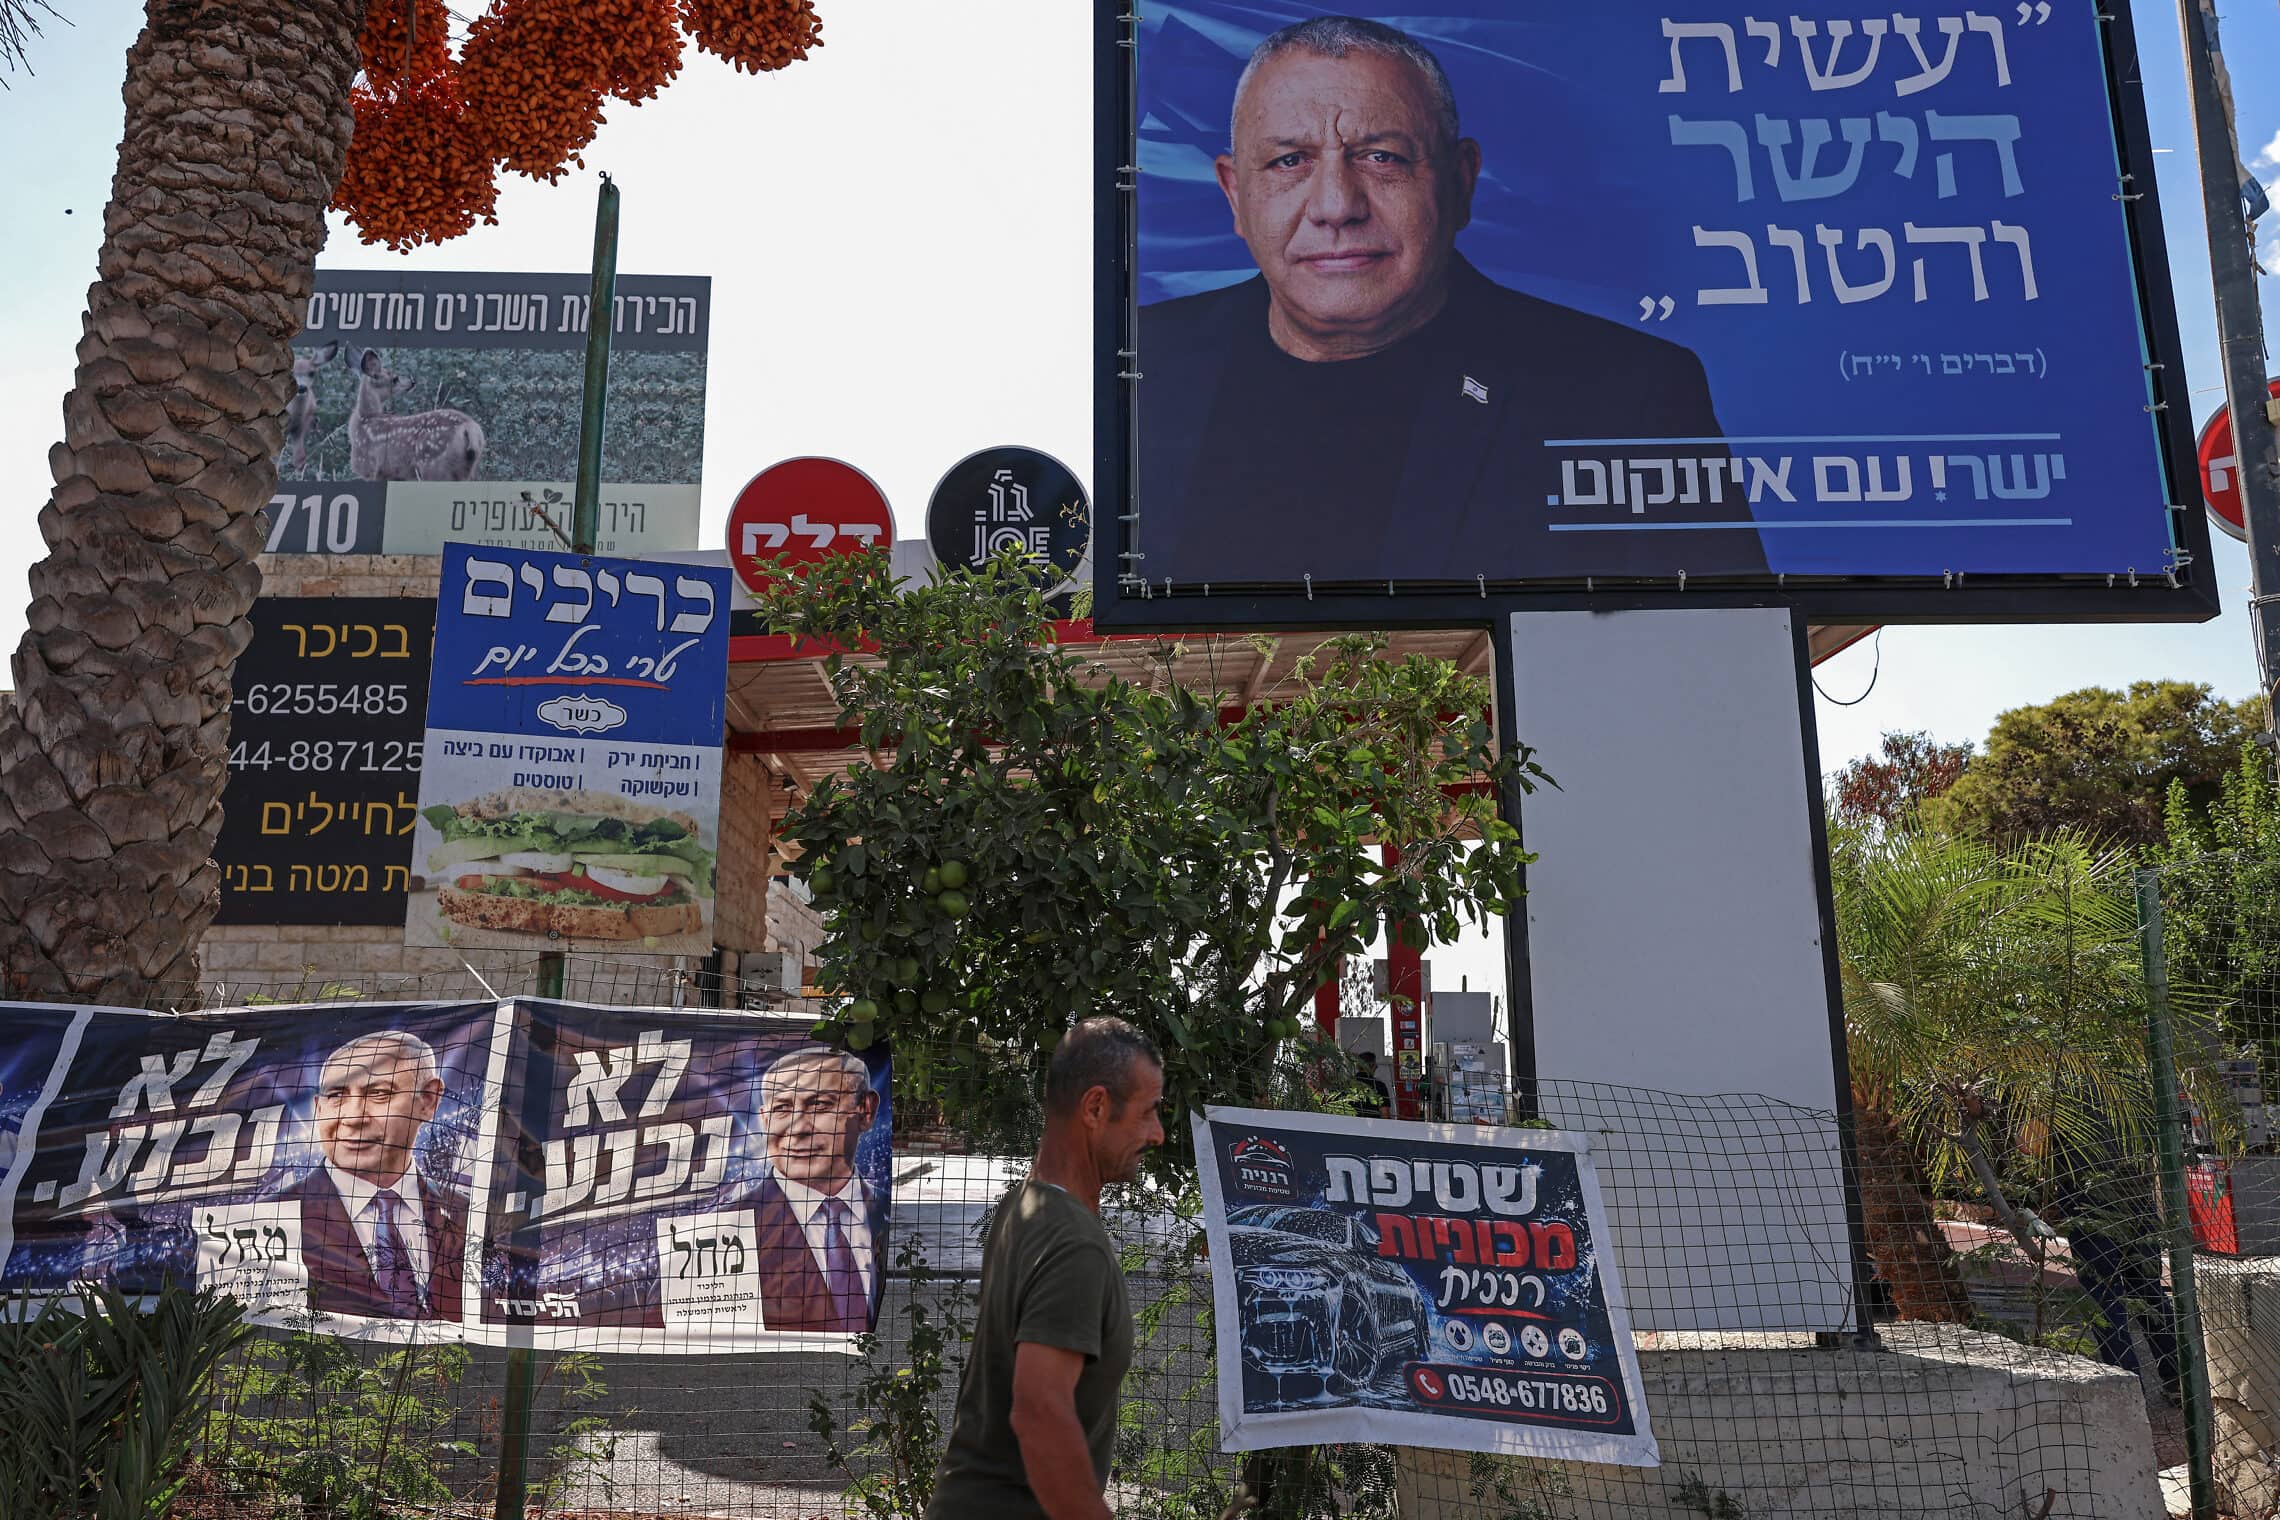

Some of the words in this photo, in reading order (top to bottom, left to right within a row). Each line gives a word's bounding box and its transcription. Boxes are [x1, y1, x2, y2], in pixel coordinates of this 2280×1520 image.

[1668, 110, 2024, 202] הישר
[306, 292, 424, 331] החדשים
[434, 293, 549, 332] השכנים
[614, 295, 698, 335] הכירו
[1940, 348, 2046, 379] (דברים
[1547, 455, 1797, 513] איזנקוט.
[1812, 456, 1912, 503] עם
[1929, 454, 2066, 503] ישר!
[741, 513, 882, 556] דלק
[968, 514, 1051, 567] JOE
[463, 556, 715, 634] כריכים
[282, 624, 410, 658] בכיכר
[472, 645, 537, 675] יום
[546, 625, 609, 675] בכל
[626, 639, 699, 682] טרי
[233, 684, 408, 715] -6255485
[562, 706, 602, 722] כשר
[227, 740, 424, 772] 44-887125
[444, 740, 483, 757] ביצה
[489, 743, 513, 759] עם
[519, 746, 576, 764] אבוקדו
[608, 751, 636, 768] ירק
[640, 753, 691, 770] חביתת
[513, 772, 574, 790] טוסטים
[621, 778, 690, 798] שקשוקה
[261, 791, 418, 836] לחיילים
[225, 864, 274, 892] בני
[289, 864, 369, 892] מטה
[108, 1029, 261, 1119] לא
[563, 1029, 692, 1128] לא
[504, 1115, 734, 1220] נכנע.
[1324, 1153, 1537, 1216] שטיפת
[206, 1213, 288, 1264] מחל
[670, 1223, 745, 1280] מחל
[1376, 1212, 1577, 1270] מכוניות
[494, 1292, 581, 1318] הליכוד
[1447, 1373, 1608, 1414] 0548-677836
